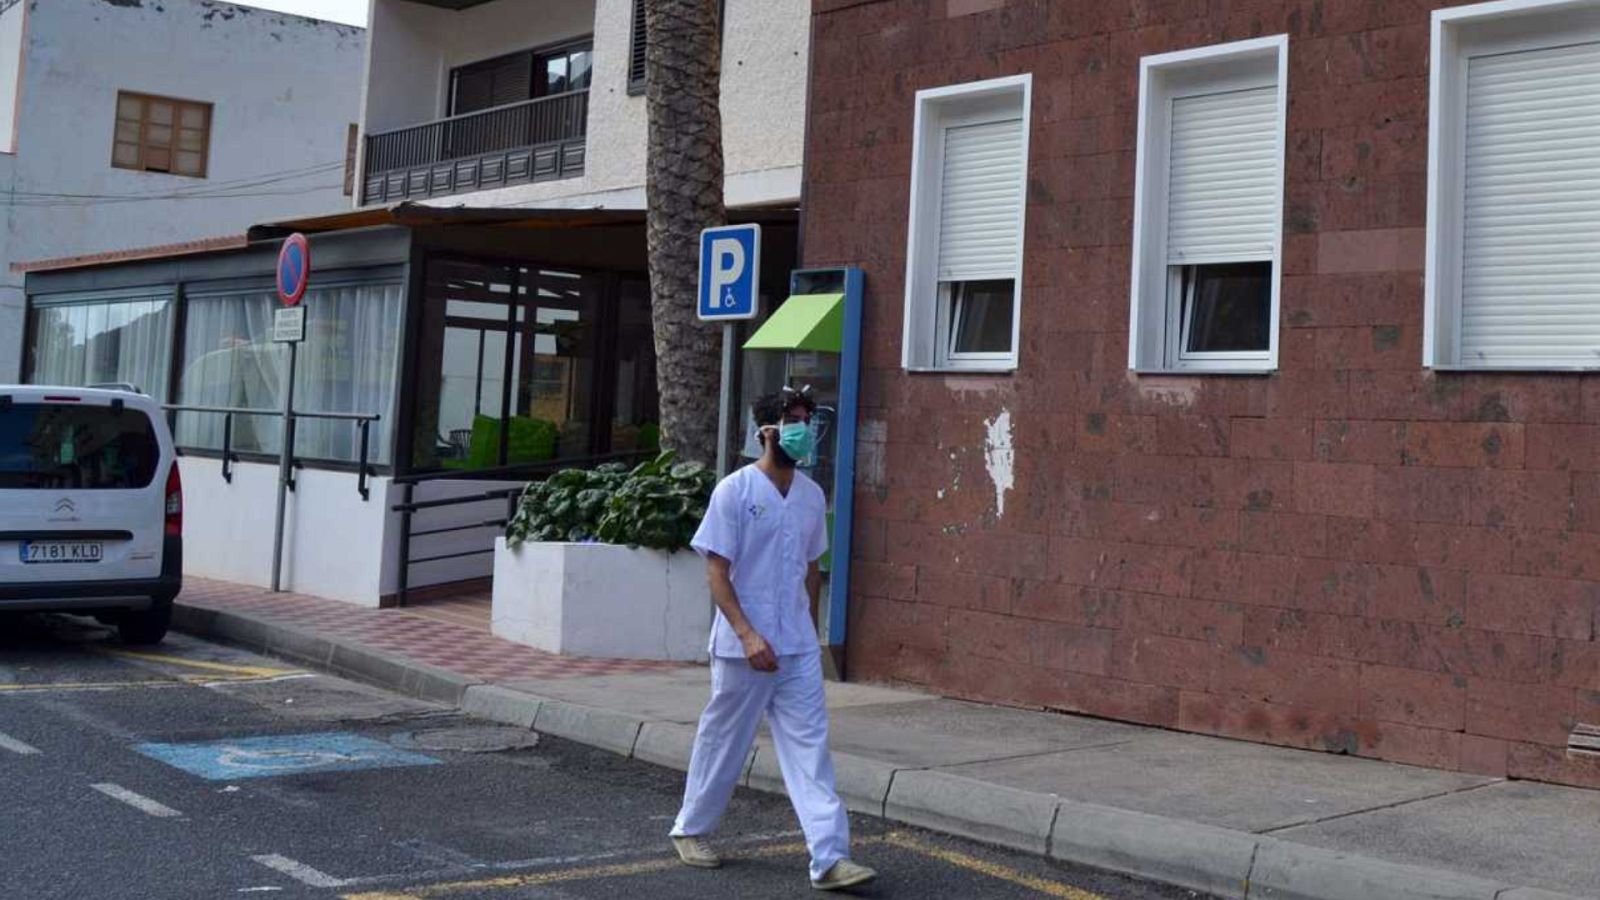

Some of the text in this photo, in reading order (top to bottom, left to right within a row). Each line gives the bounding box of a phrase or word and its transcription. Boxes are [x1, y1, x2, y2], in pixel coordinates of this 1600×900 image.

[709, 238, 745, 308] P
[30, 544, 100, 558] 7181 KLD
